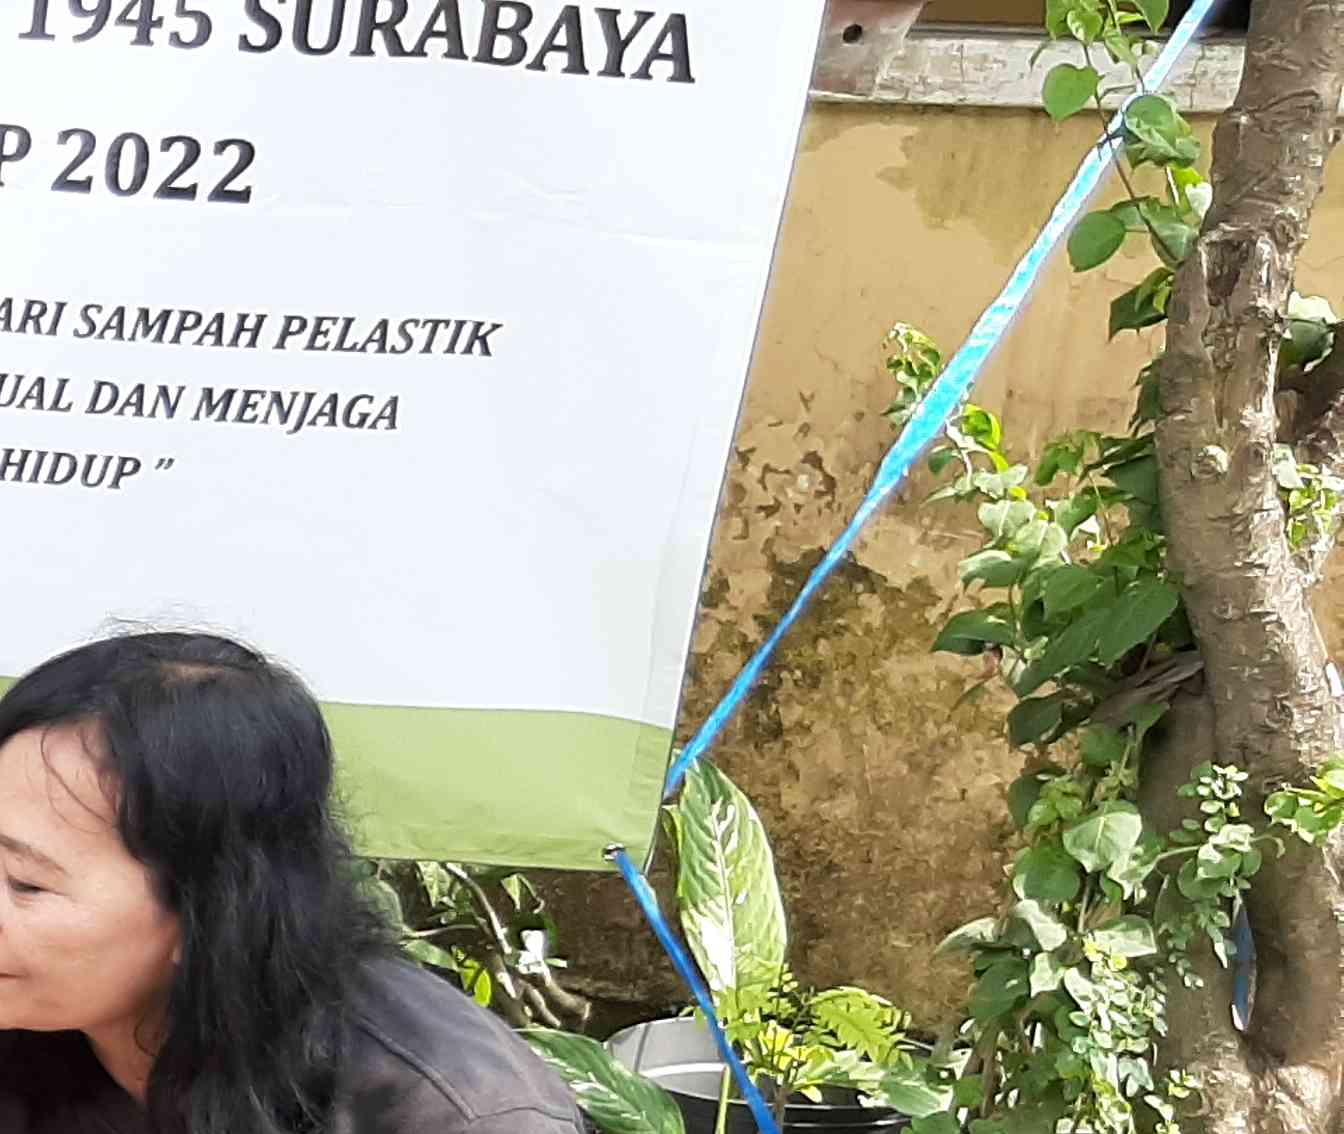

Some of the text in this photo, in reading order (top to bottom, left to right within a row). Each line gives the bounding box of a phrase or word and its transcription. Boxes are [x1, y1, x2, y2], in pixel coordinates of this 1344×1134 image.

[18, 0, 213, 49] 1945
[238, 0, 696, 83] SURABAYA
[51, 127, 256, 204] 2022
[73, 303, 268, 349] SAMPAH
[273, 315, 504, 357] PELASTIK
[84, 380, 186, 419] DAN
[191, 387, 399, 435] MENJAGA
